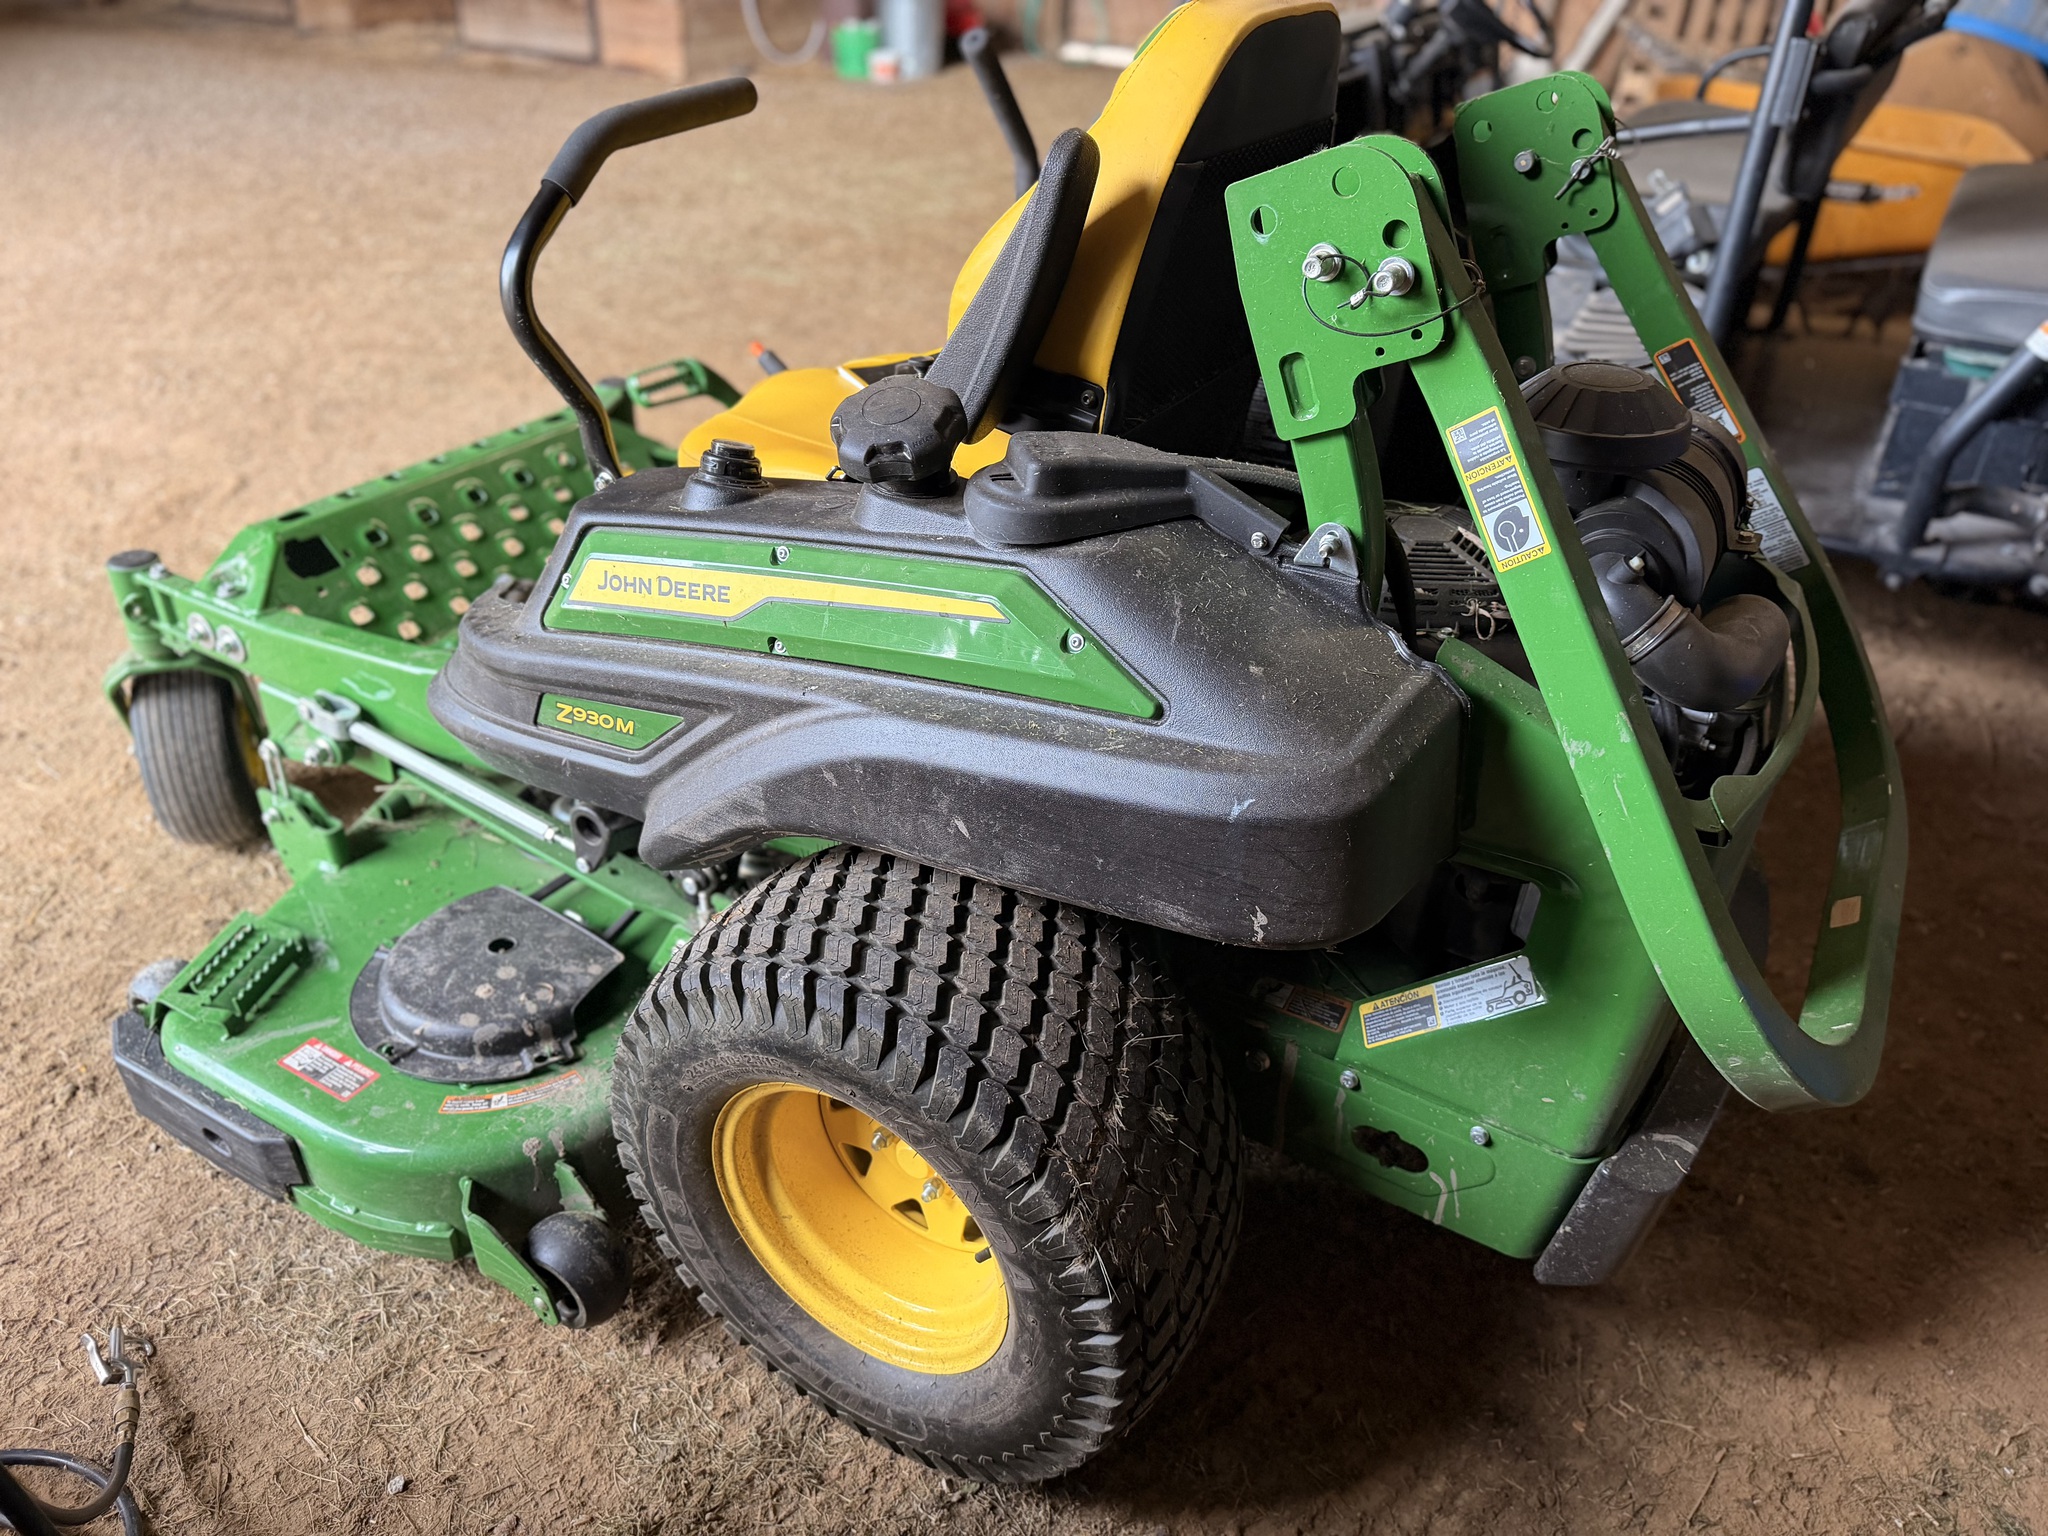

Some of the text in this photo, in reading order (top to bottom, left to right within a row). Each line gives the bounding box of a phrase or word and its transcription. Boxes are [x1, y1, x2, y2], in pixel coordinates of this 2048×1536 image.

[1464, 457, 1506, 483] ATENCIÓN
[1500, 549, 1538, 569] CAUTION
[597, 570, 731, 604] JOHN DEERE
[555, 702, 635, 736] Z930M
[1379, 989, 1420, 1008] ATENCIÓN
[880, 1107, 1036, 1291] KENDA
